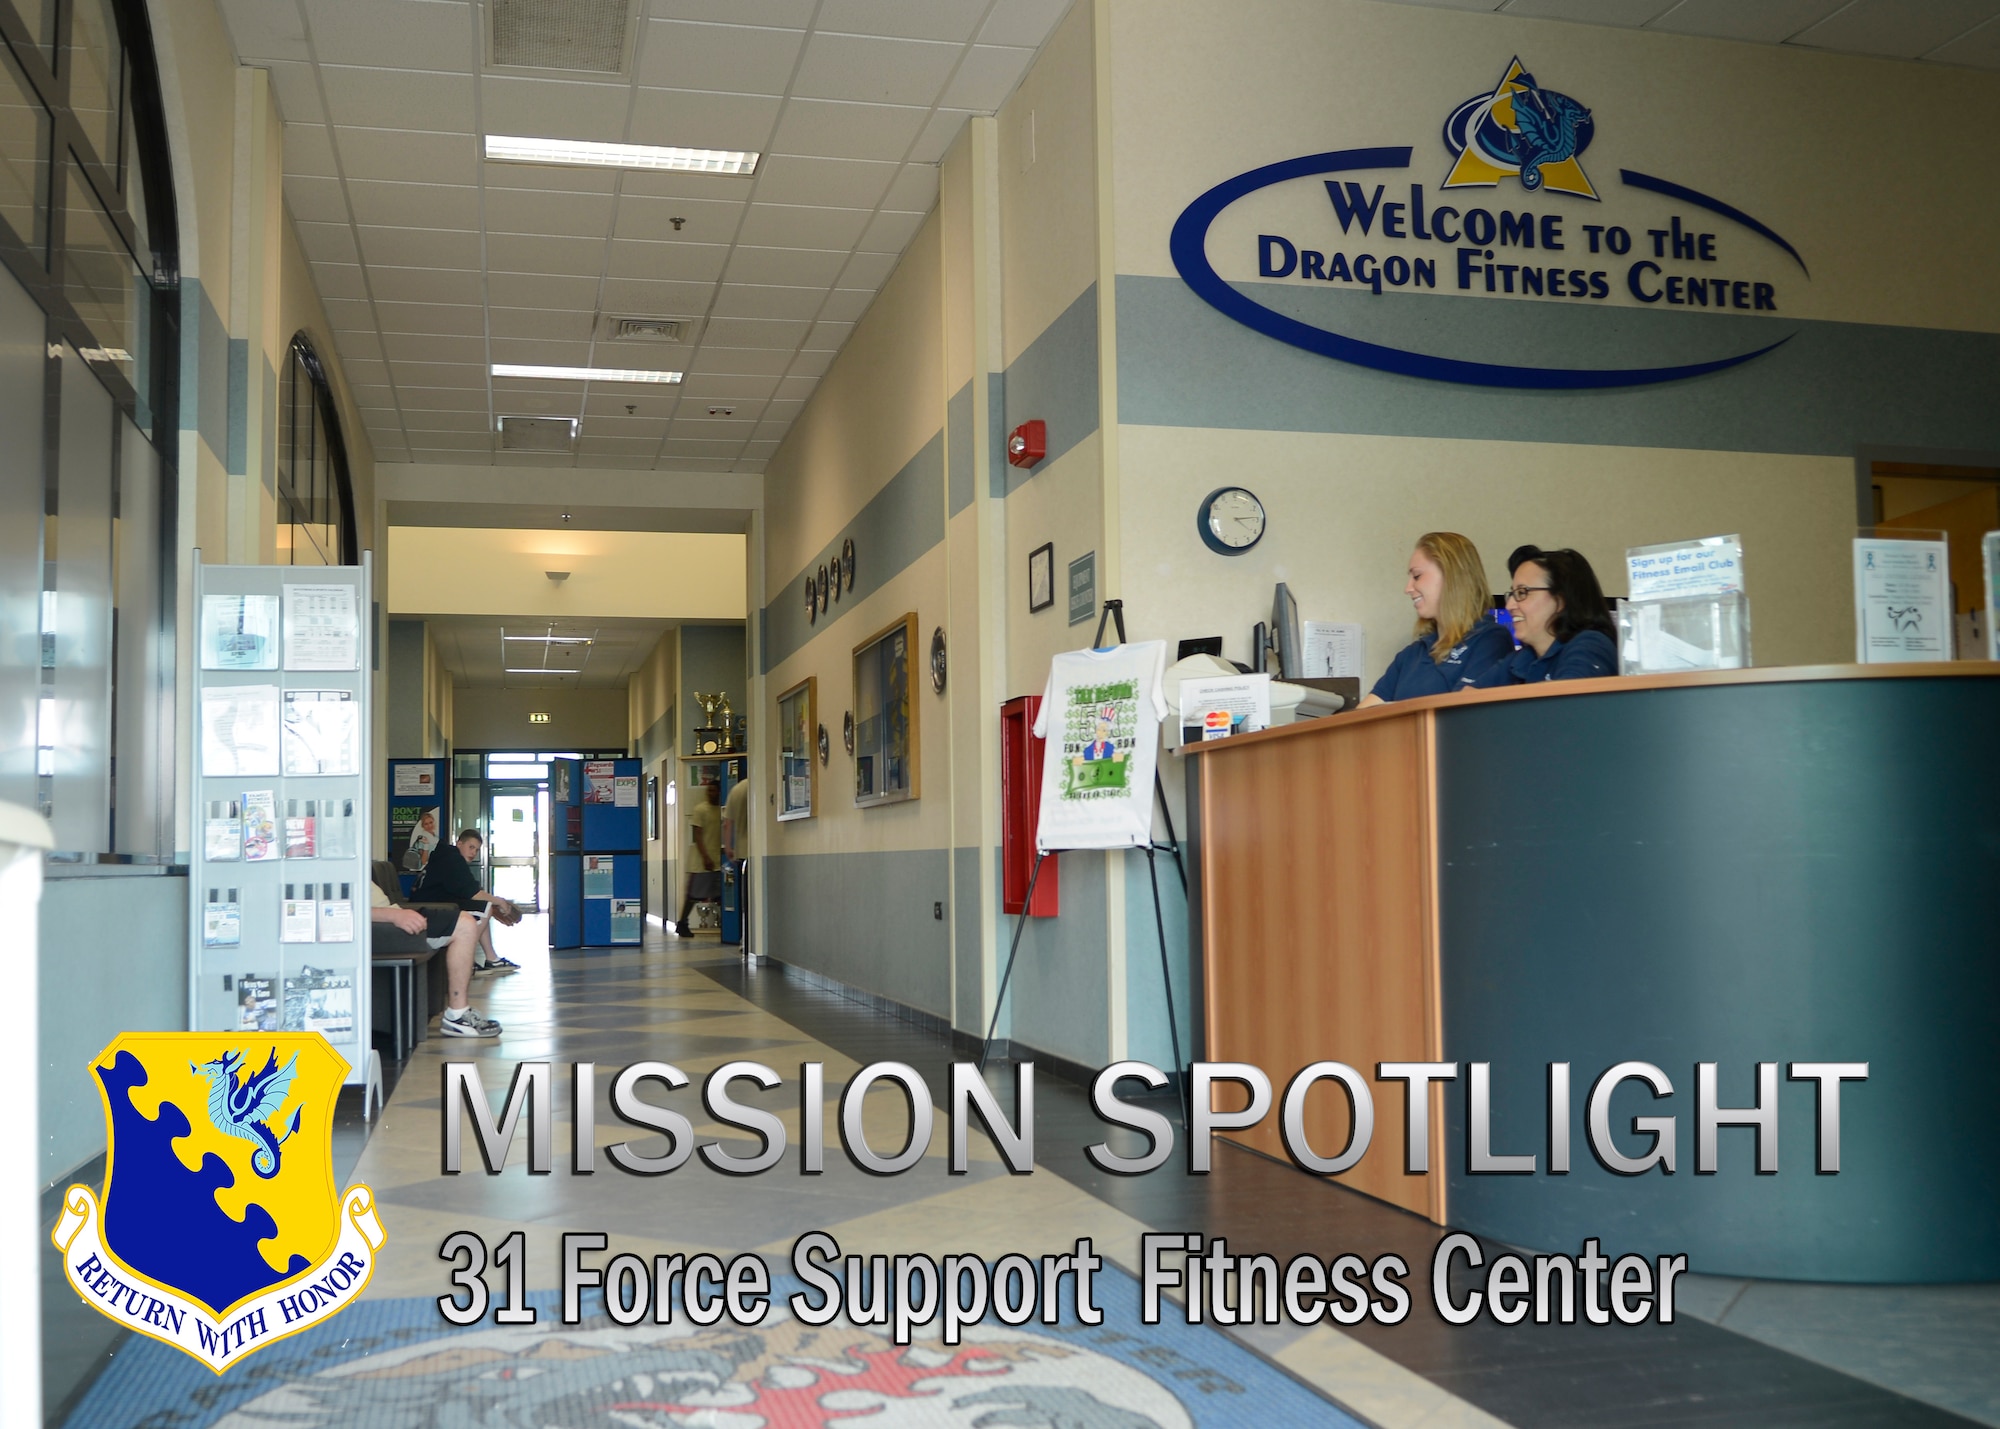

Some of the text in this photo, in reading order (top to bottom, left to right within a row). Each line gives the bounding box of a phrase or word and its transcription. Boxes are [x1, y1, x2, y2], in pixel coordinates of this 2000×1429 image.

[1582, 223, 1631, 255] TO
[1648, 216, 1717, 262] THE
[1257, 233, 1778, 311] DRAGON FITNESS CENTER
[1631, 550, 1716, 568] Sign up for our
[1632, 559, 1734, 580] Fitness Email Club
